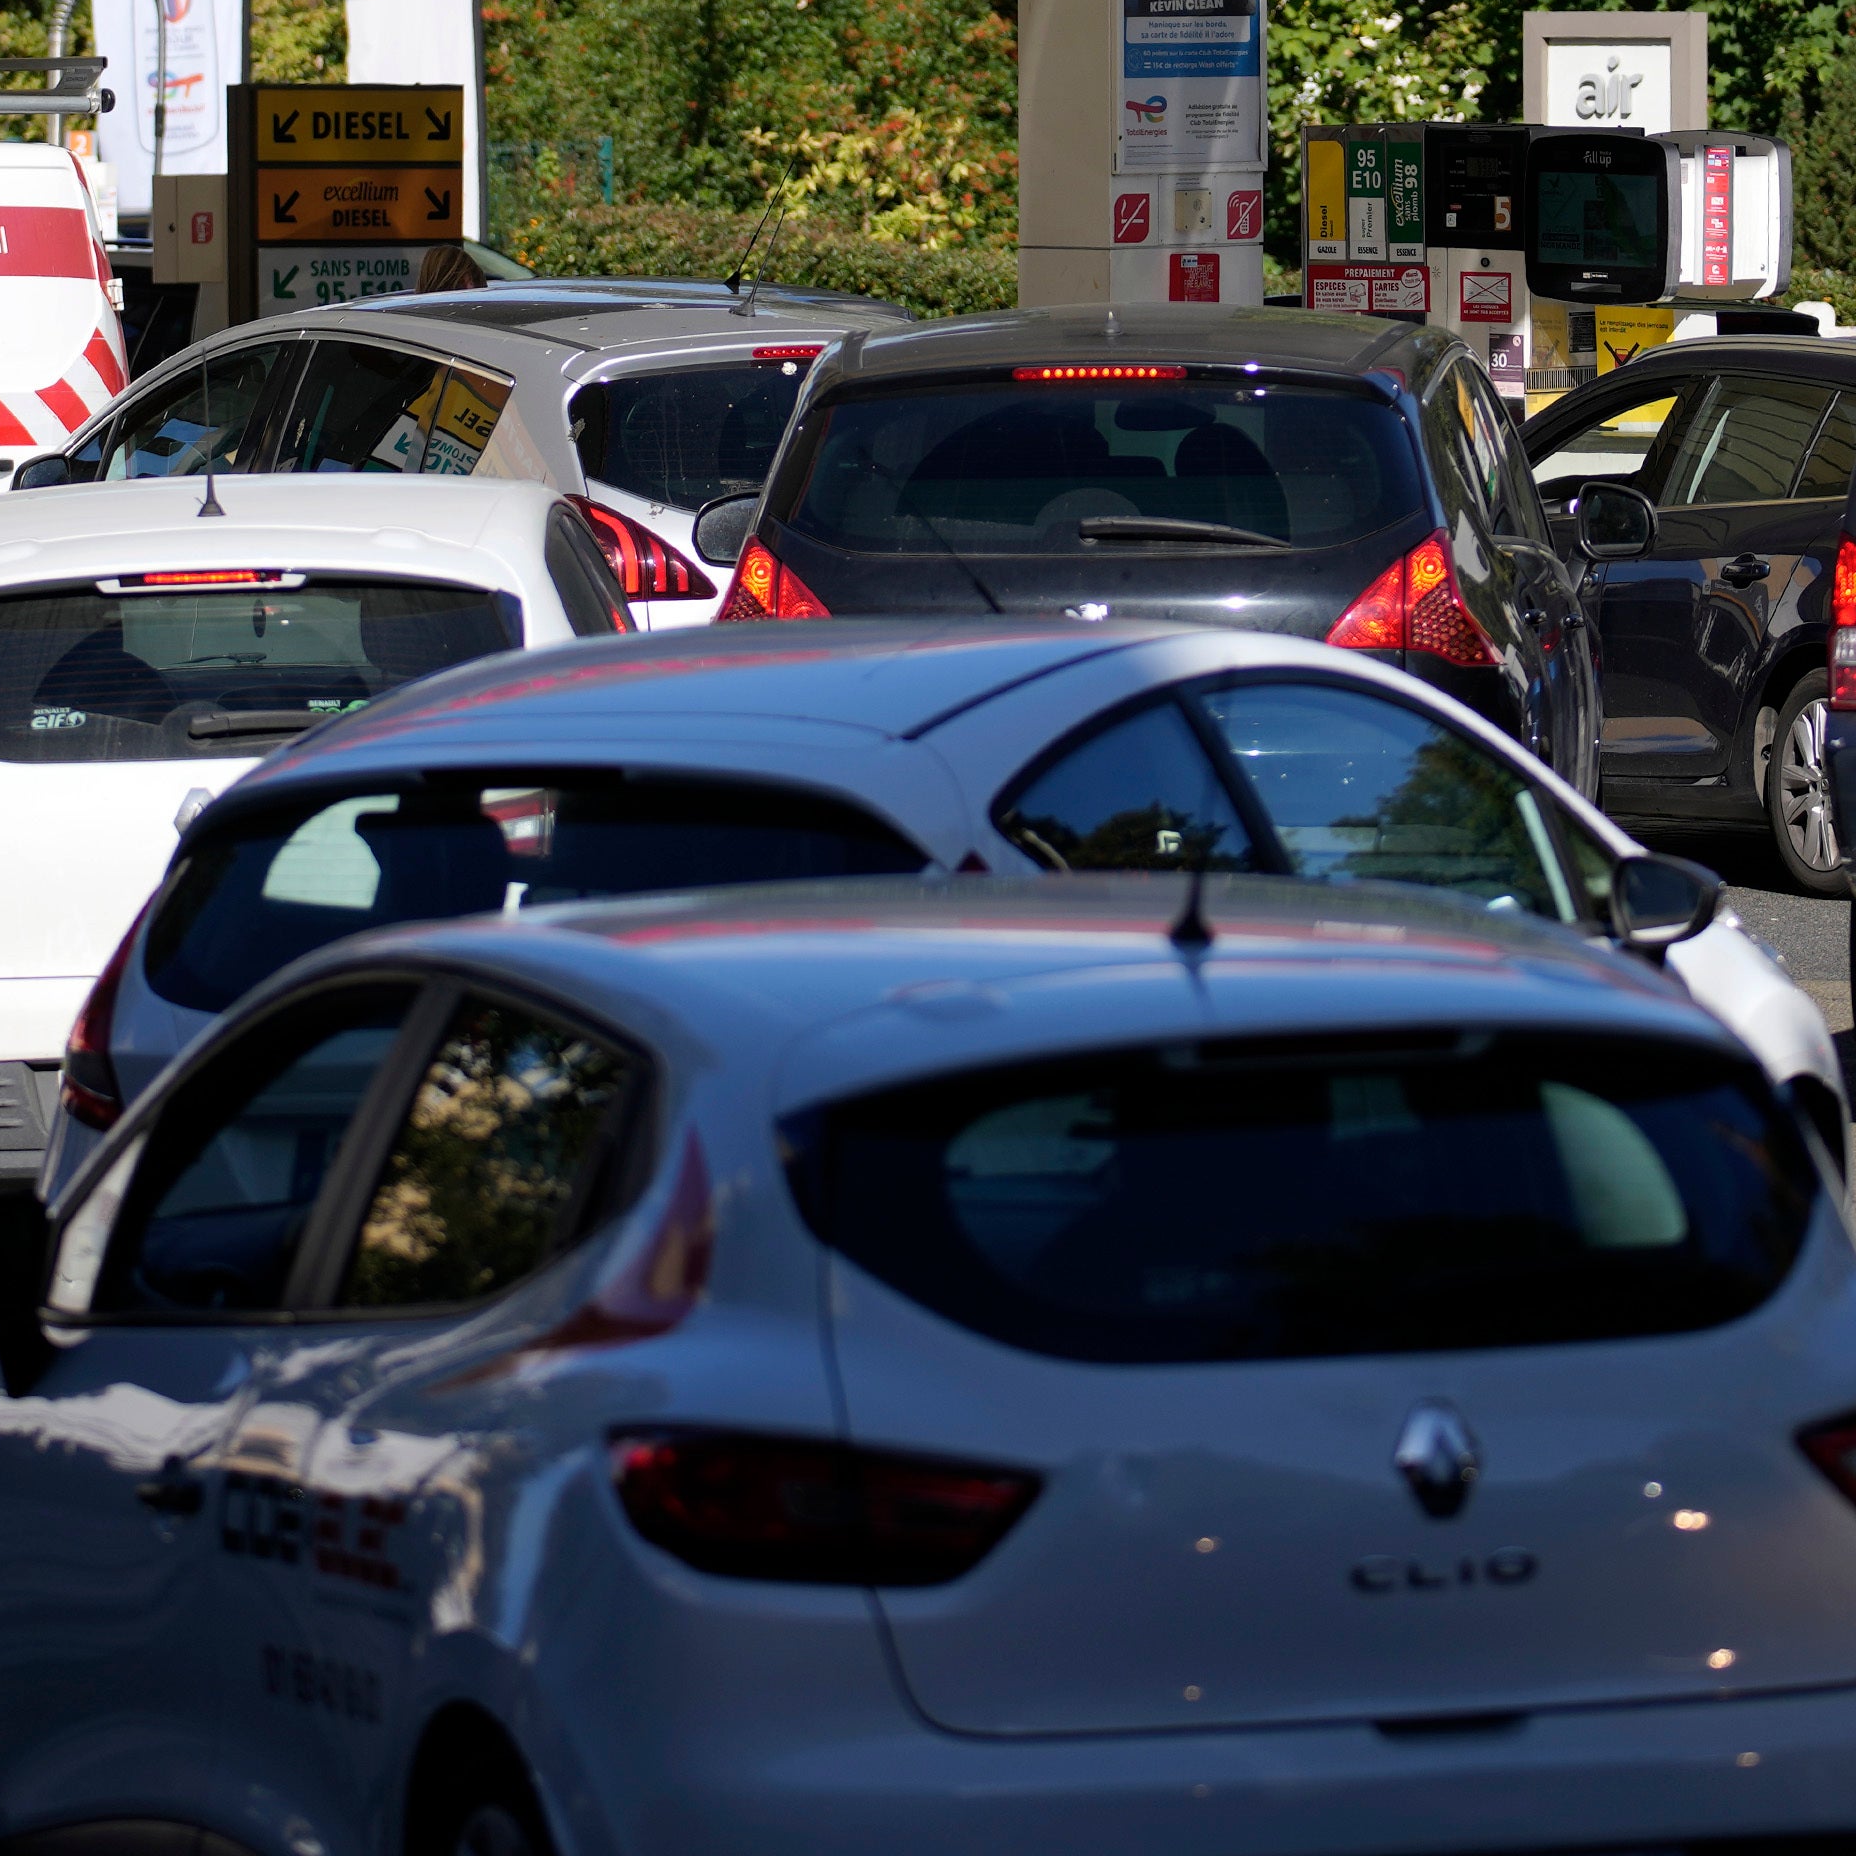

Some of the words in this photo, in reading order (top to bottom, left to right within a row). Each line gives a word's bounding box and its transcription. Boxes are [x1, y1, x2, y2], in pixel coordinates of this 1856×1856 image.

[1576, 55, 1643, 120] air
[312, 110, 410, 140] DIESEL
[1126, 128, 1168, 138] TotalEnergies
[75, 133, 89, 150] 2
[1357, 148, 1376, 168] 95
[1352, 170, 1382, 189] E10
[1404, 164, 1419, 189] 98
[323, 181, 400, 202] excellium
[1394, 158, 1405, 227] excellium
[1412, 191, 1420, 222] plomb
[1495, 196, 1511, 230] 5
[332, 209, 391, 227] DIESEL
[1319, 205, 1328, 238] Diesel
[1317, 246, 1337, 254] GAZOLE
[1357, 246, 1378, 255] ESSENCE
[1396, 248, 1417, 257] ESSENCE
[310, 259, 351, 277] SANS
[356, 258, 410, 277] PLOMB
[1344, 268, 1396, 278] PREPAIEMENT
[1315, 281, 1347, 291] ESPECES
[1374, 282, 1400, 292] CARTES
[1491, 353, 1508, 369] 30
[1349, 1547, 1539, 1592] CLIO
